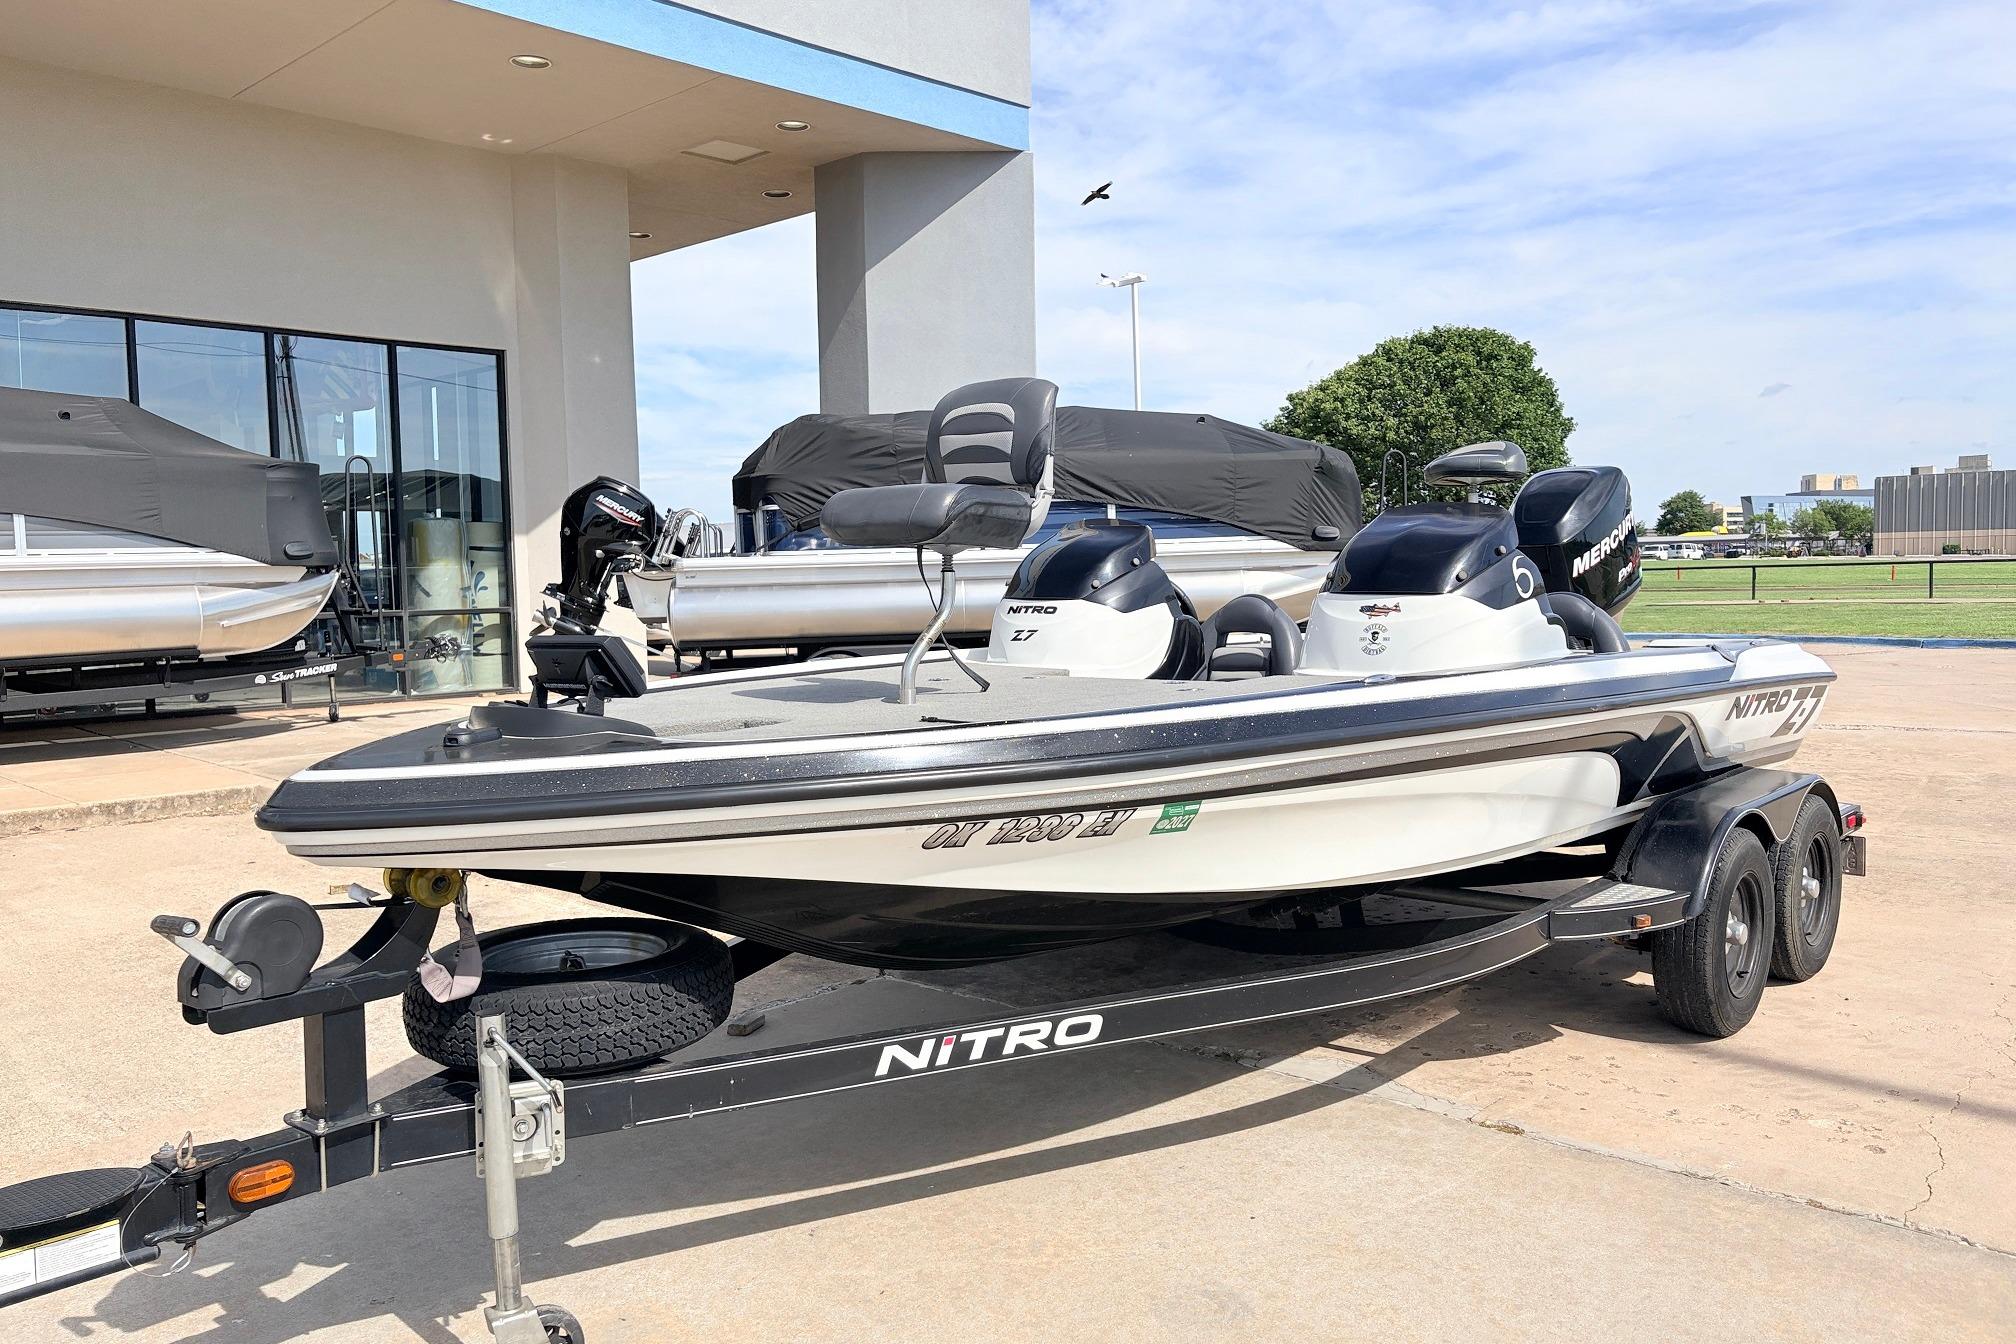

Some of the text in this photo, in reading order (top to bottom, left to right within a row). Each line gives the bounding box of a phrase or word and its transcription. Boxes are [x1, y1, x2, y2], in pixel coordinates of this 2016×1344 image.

[595, 494, 646, 523] MERCURY
[1007, 605, 1058, 615] NITRO
[1010, 629, 1039, 642] Z7
[269, 663, 338, 683] Sun TRACKER
[1725, 688, 1793, 721] NITRO
[921, 820, 990, 850] OK
[986, 813, 1084, 846] 1236
[1164, 814, 1196, 829] 2027
[874, 1013, 1105, 1077] NITRO
